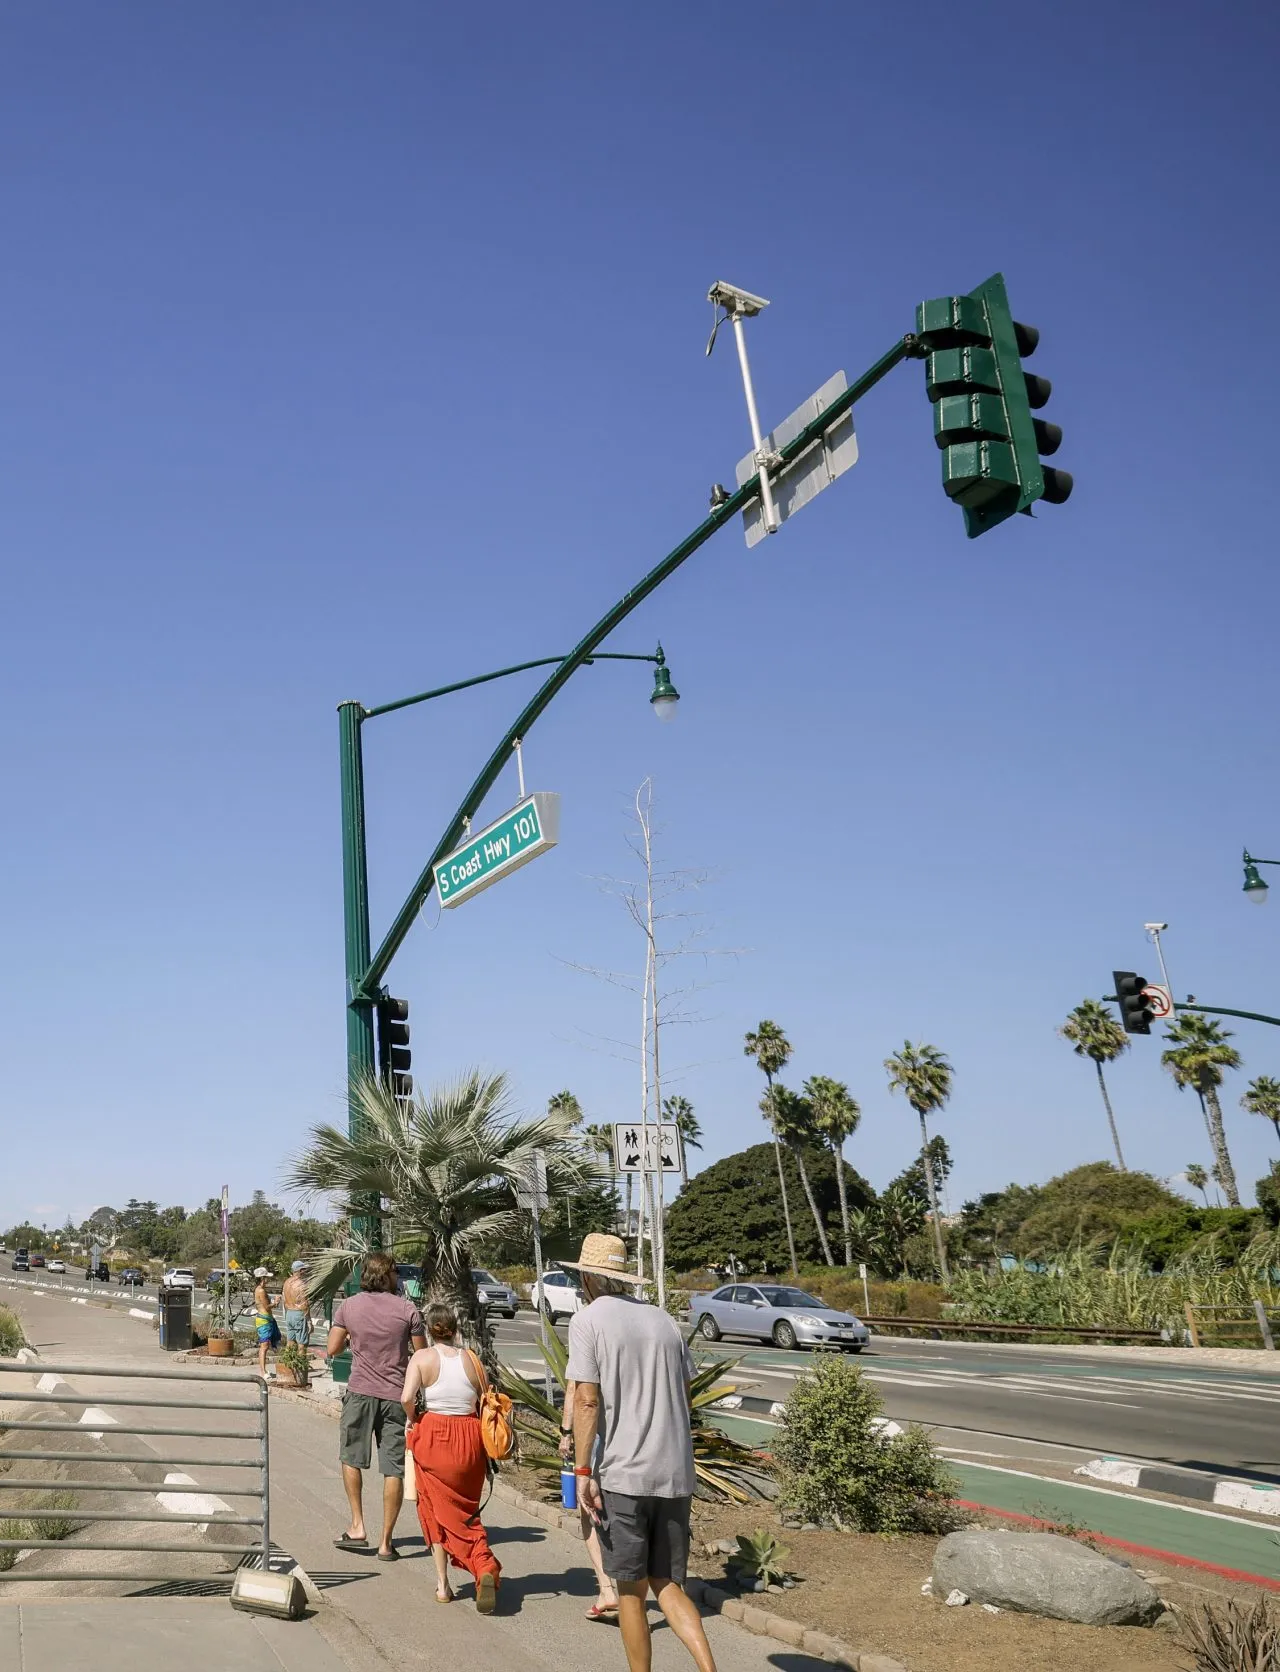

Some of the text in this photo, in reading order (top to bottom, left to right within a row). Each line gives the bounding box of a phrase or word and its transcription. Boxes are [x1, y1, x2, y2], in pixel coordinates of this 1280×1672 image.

[440, 812, 537, 892] S Coast Hwy 101
